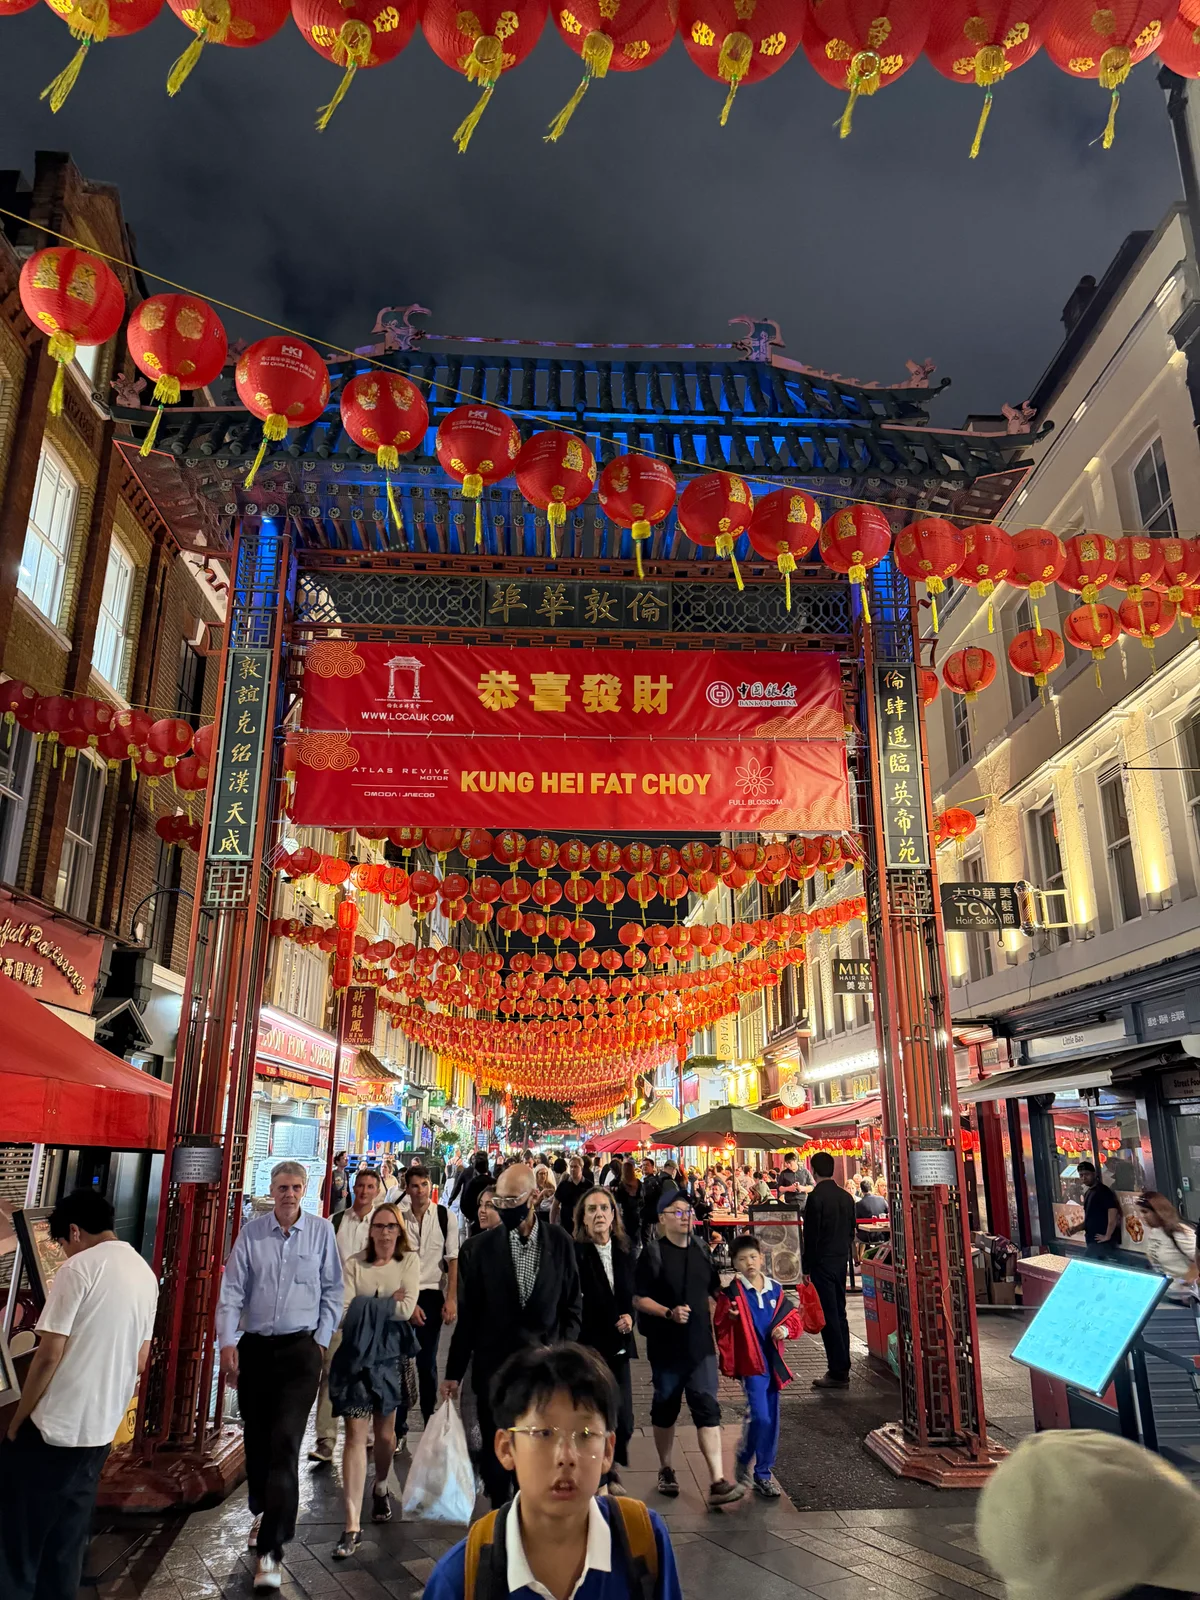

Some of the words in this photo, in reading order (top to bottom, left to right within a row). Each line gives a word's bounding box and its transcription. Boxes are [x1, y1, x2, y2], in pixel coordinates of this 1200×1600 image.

[281, 345, 303, 359] HKI
[478, 670, 673, 714] 恭喜發財
[361, 711, 455, 722] WWW.LCCAUK.COM
[461, 771, 535, 793] KUNG
[541, 772, 584, 794] HEI
[590, 773, 643, 794] FAT
[642, 773, 711, 795] CHOY
[954, 902, 996, 916] TCW
[955, 916, 973, 925] Hair
[839, 962, 872, 975] MIK
